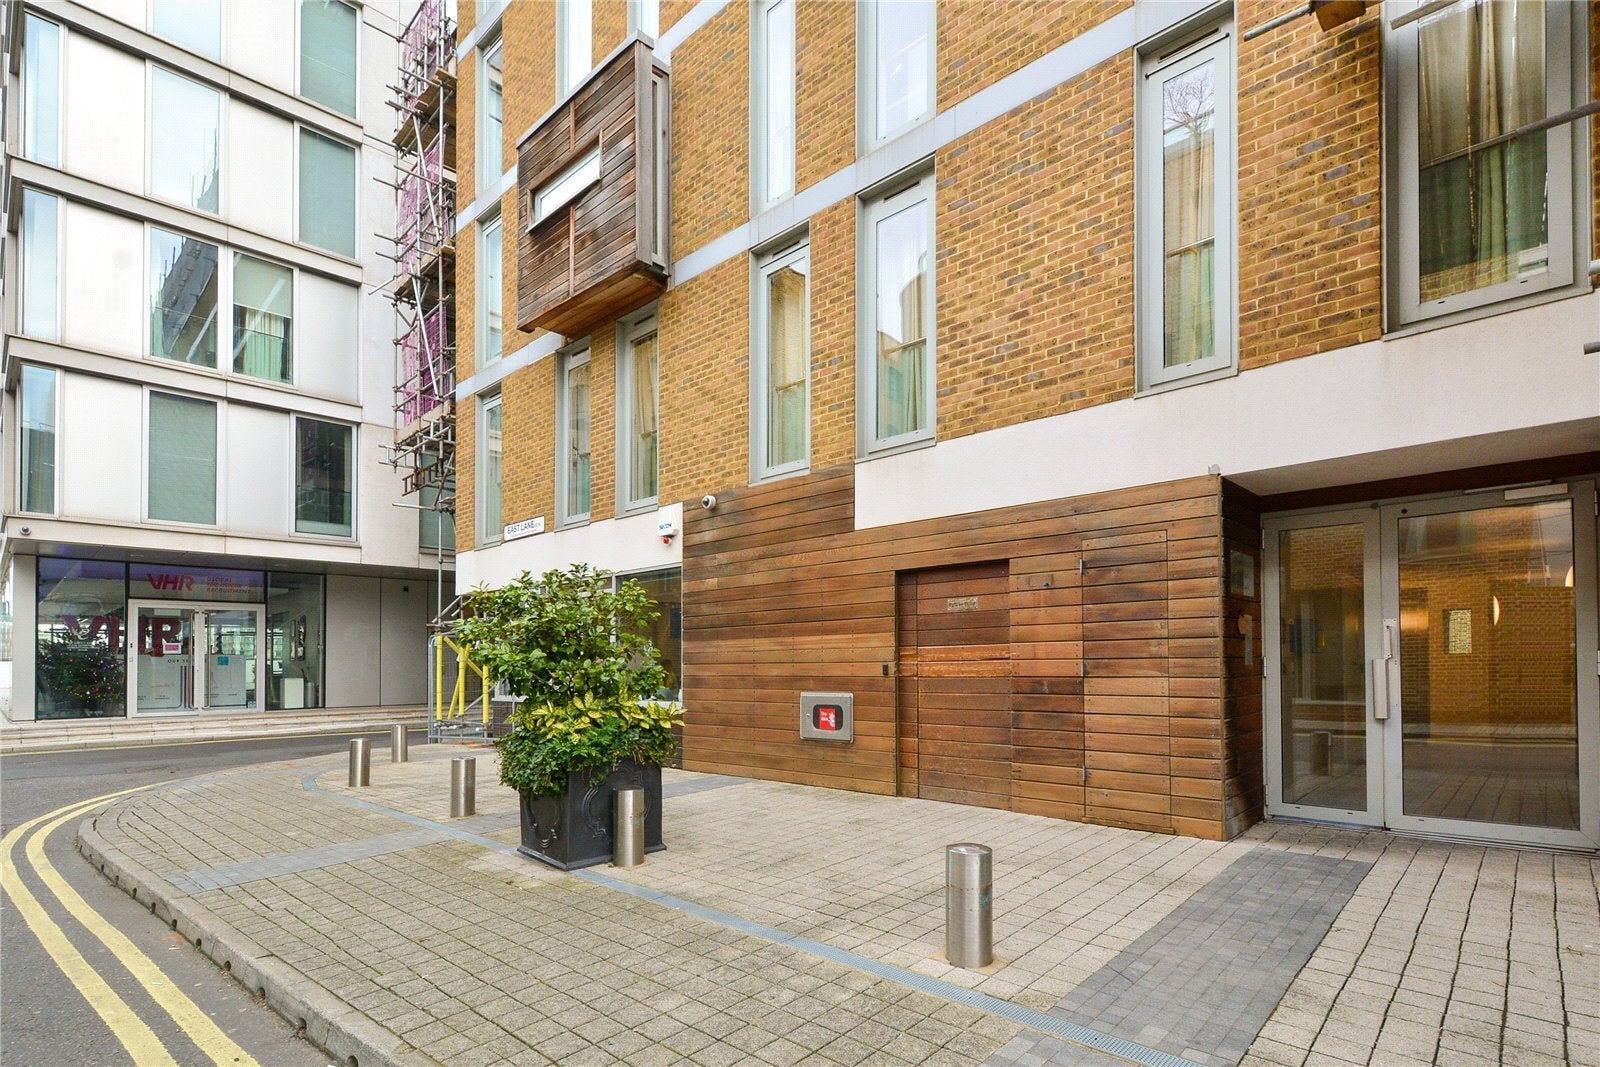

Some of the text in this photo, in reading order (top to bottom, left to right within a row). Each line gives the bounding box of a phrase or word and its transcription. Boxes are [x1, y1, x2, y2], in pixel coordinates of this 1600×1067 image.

[507, 524, 520, 535] EAST
[520, 520, 535, 531] LANE
[146, 573, 195, 592] VHR
